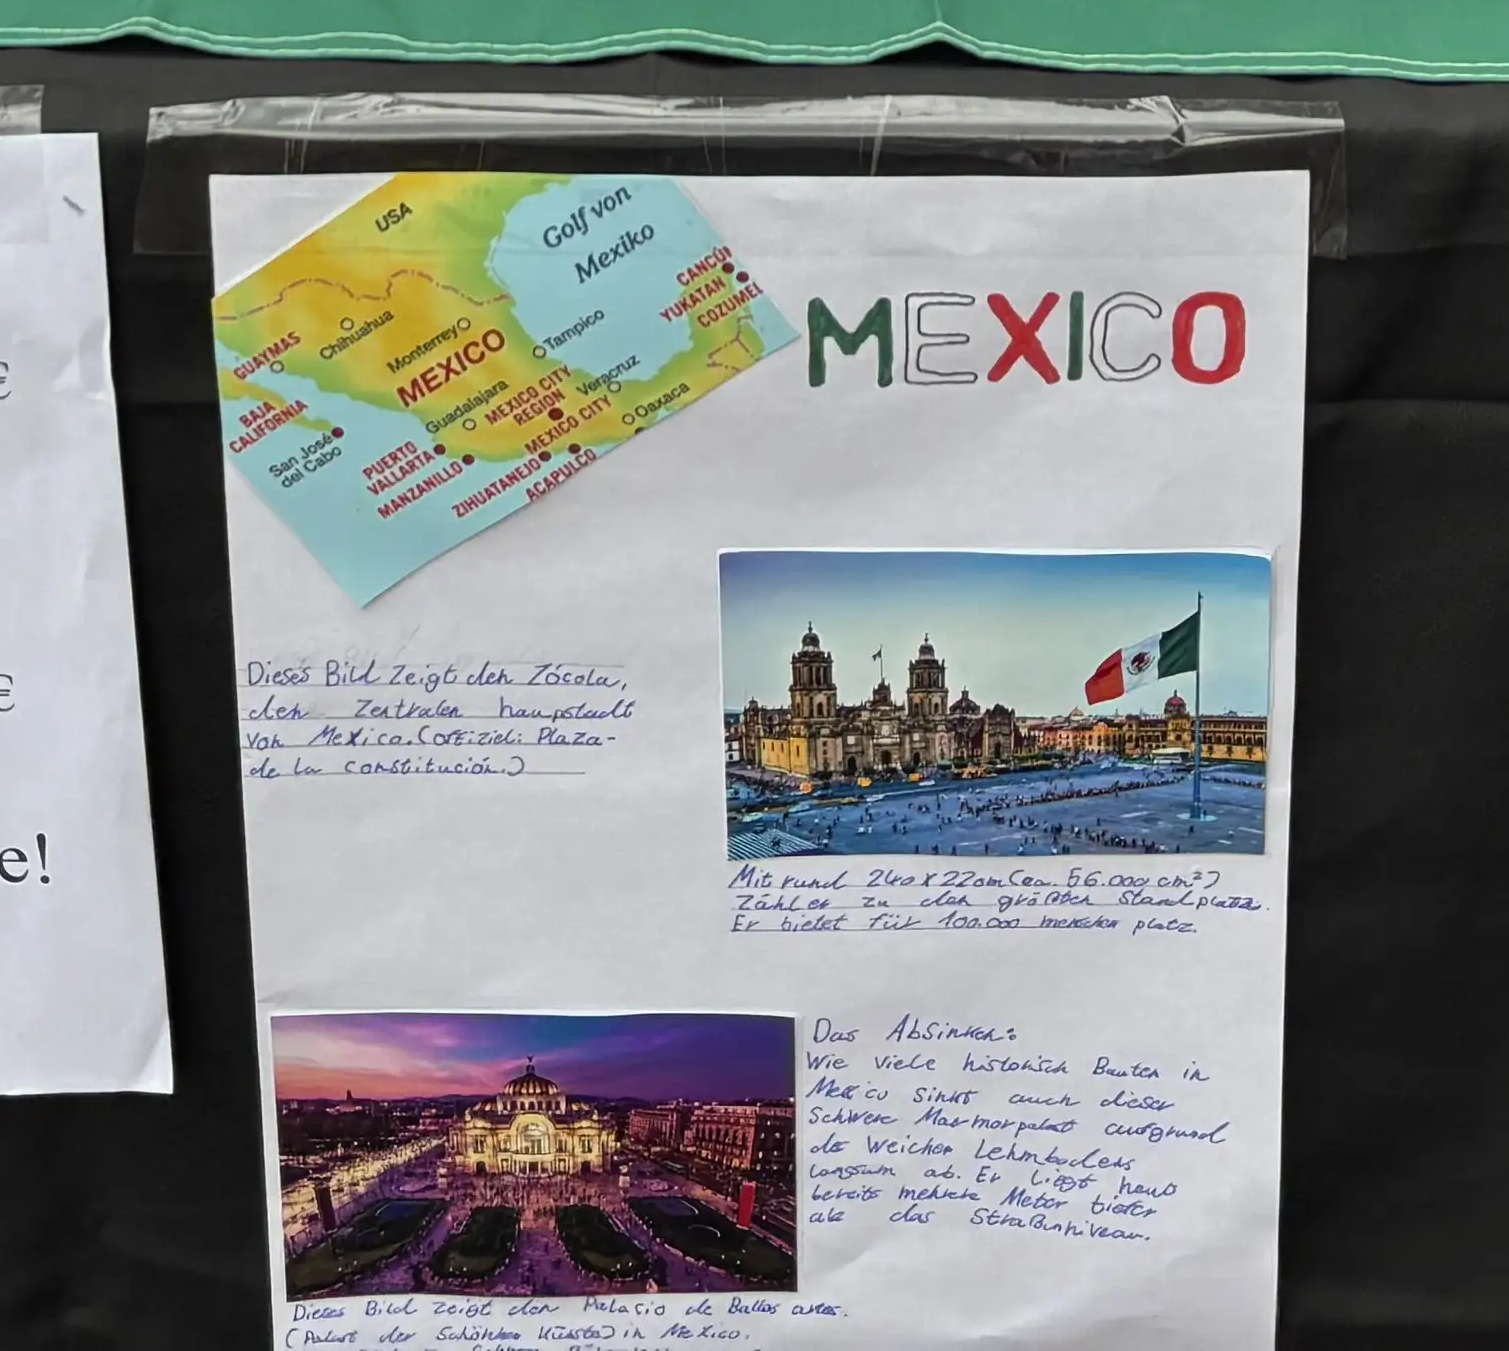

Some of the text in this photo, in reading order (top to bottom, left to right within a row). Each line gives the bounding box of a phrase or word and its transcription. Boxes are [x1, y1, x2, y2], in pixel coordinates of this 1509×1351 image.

[374, 201, 413, 233] USA
[543, 186, 632, 249] Golf von
[574, 223, 654, 284] Mexiko
[659, 276, 727, 323] YUKATAN
[697, 281, 764, 328] COZUMEL
[319, 310, 395, 360] Chihuahua
[386, 324, 459, 375] Monterrey
[543, 308, 605, 352] Tampico
[807, 291, 1247, 388] MEXICO
[233, 331, 302, 380] GUAYMAS
[396, 328, 505, 408] MEXICO
[576, 354, 641, 397] Veracruz
[239, 400, 276, 429] BAJA
[425, 378, 509, 436] Guadalajara
[484, 364, 572, 426] MEXICO CITY
[513, 388, 566, 427] REGION
[634, 381, 691, 419] Oaxaca
[229, 399, 309, 454] CALIFORNIA
[524, 394, 612, 455] MEXICO CITY
[269, 432, 334, 478] San José
[281, 445, 343, 489] del Cabo
[362, 440, 418, 481] PUERTO
[366, 449, 437, 496] VALLARTA
[525, 447, 597, 503] ACAPULCO
[377, 459, 464, 520] MANZANILLO
[451, 457, 542, 519] ZIHUATANEJO
[325, 659, 381, 687] Bild
[466, 661, 514, 686] den
[248, 694, 310, 720] den
[249, 756, 281, 779] de
[293, 757, 323, 777] la
[728, 861, 773, 890] Mit
[730, 912, 760, 933] Er
[812, 1017, 860, 1044] Das
[1182, 1060, 1211, 1081] in
[976, 1165, 1003, 1185] Er
[889, 1202, 936, 1224] das
[685, 1298, 715, 1316] de
[622, 1323, 646, 1339] in
